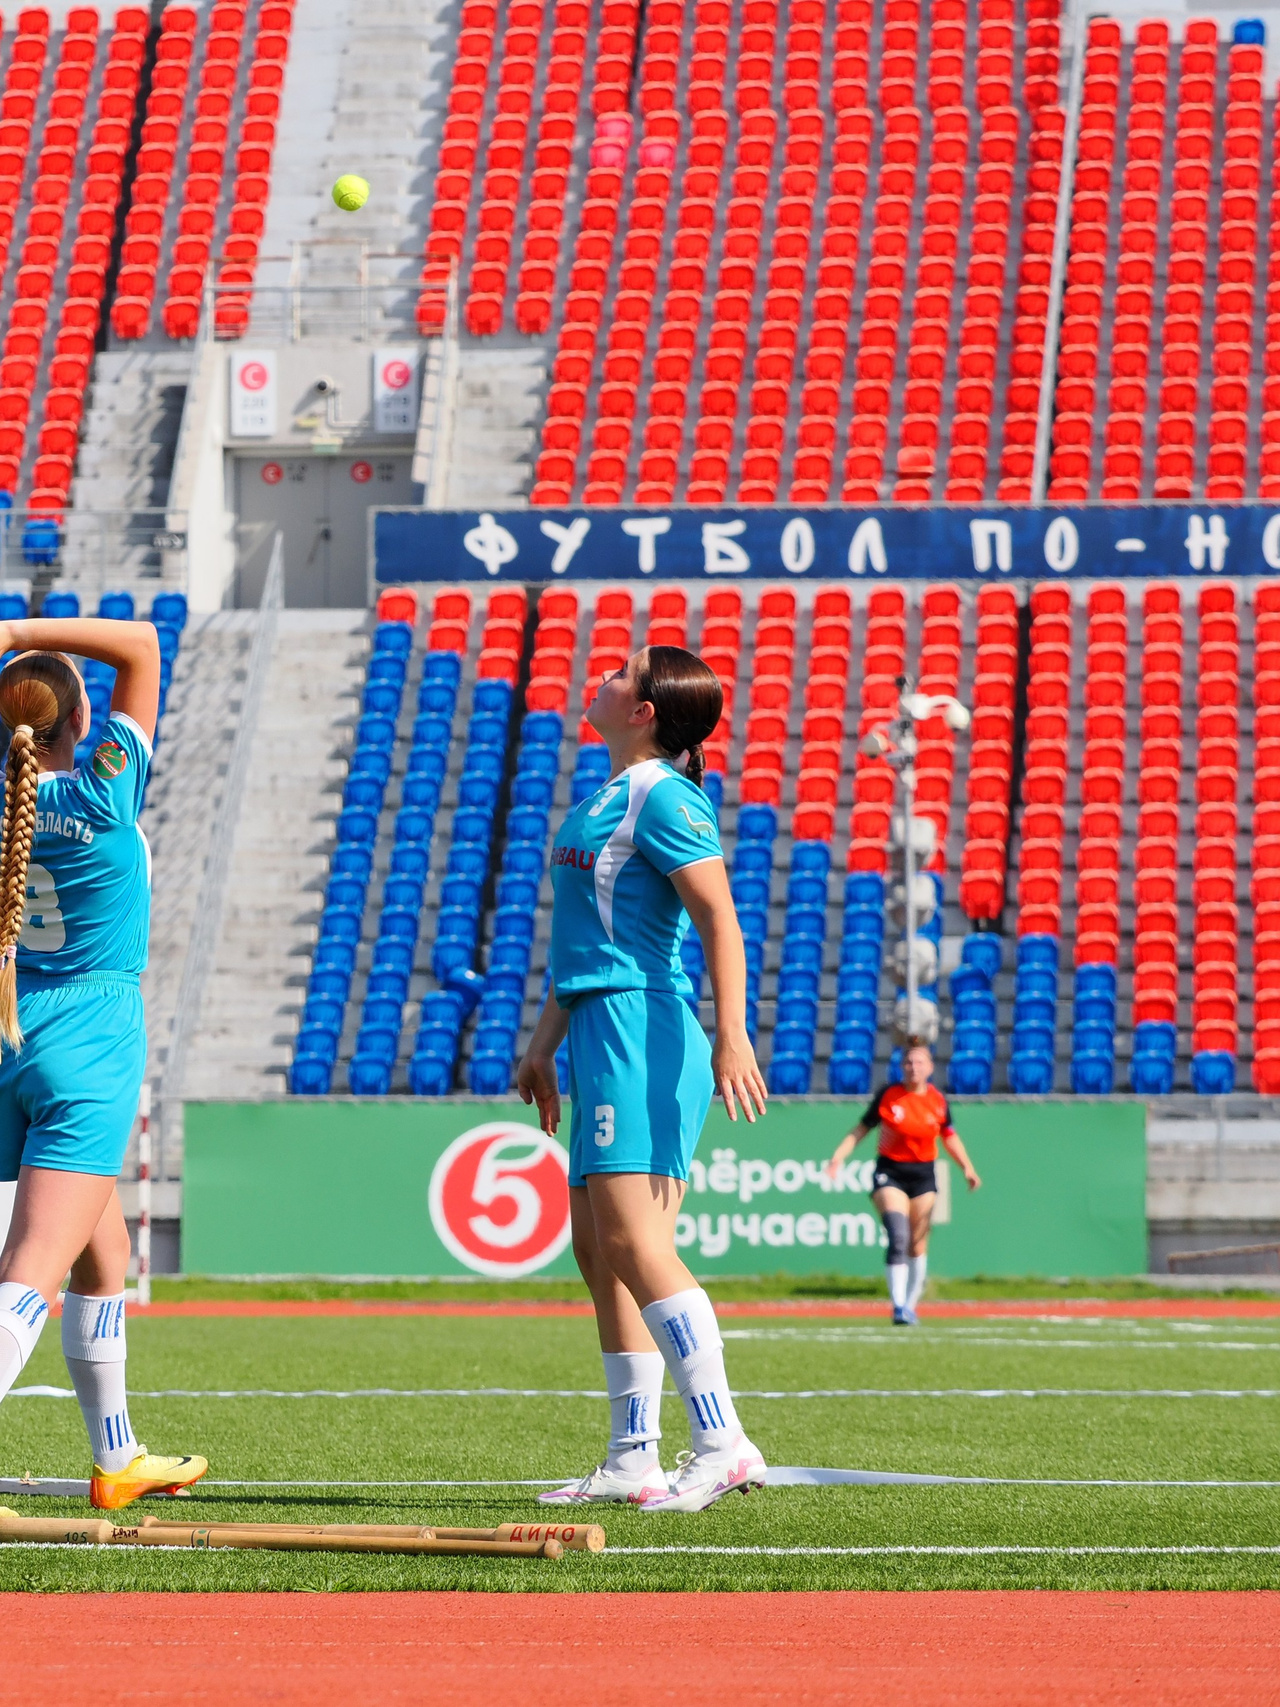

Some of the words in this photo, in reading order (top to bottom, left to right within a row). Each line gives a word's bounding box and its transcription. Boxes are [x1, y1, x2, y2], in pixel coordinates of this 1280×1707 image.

[463, 513, 888, 575] ФУТБОЛ
[34, 811, 94, 844] БЛАСТЬ
[594, 1104, 615, 1147] 3
[468, 1131, 550, 1249] 5
[64, 1531, 89, 1543] 105
[509, 1525, 576, 1543] ДИНО
